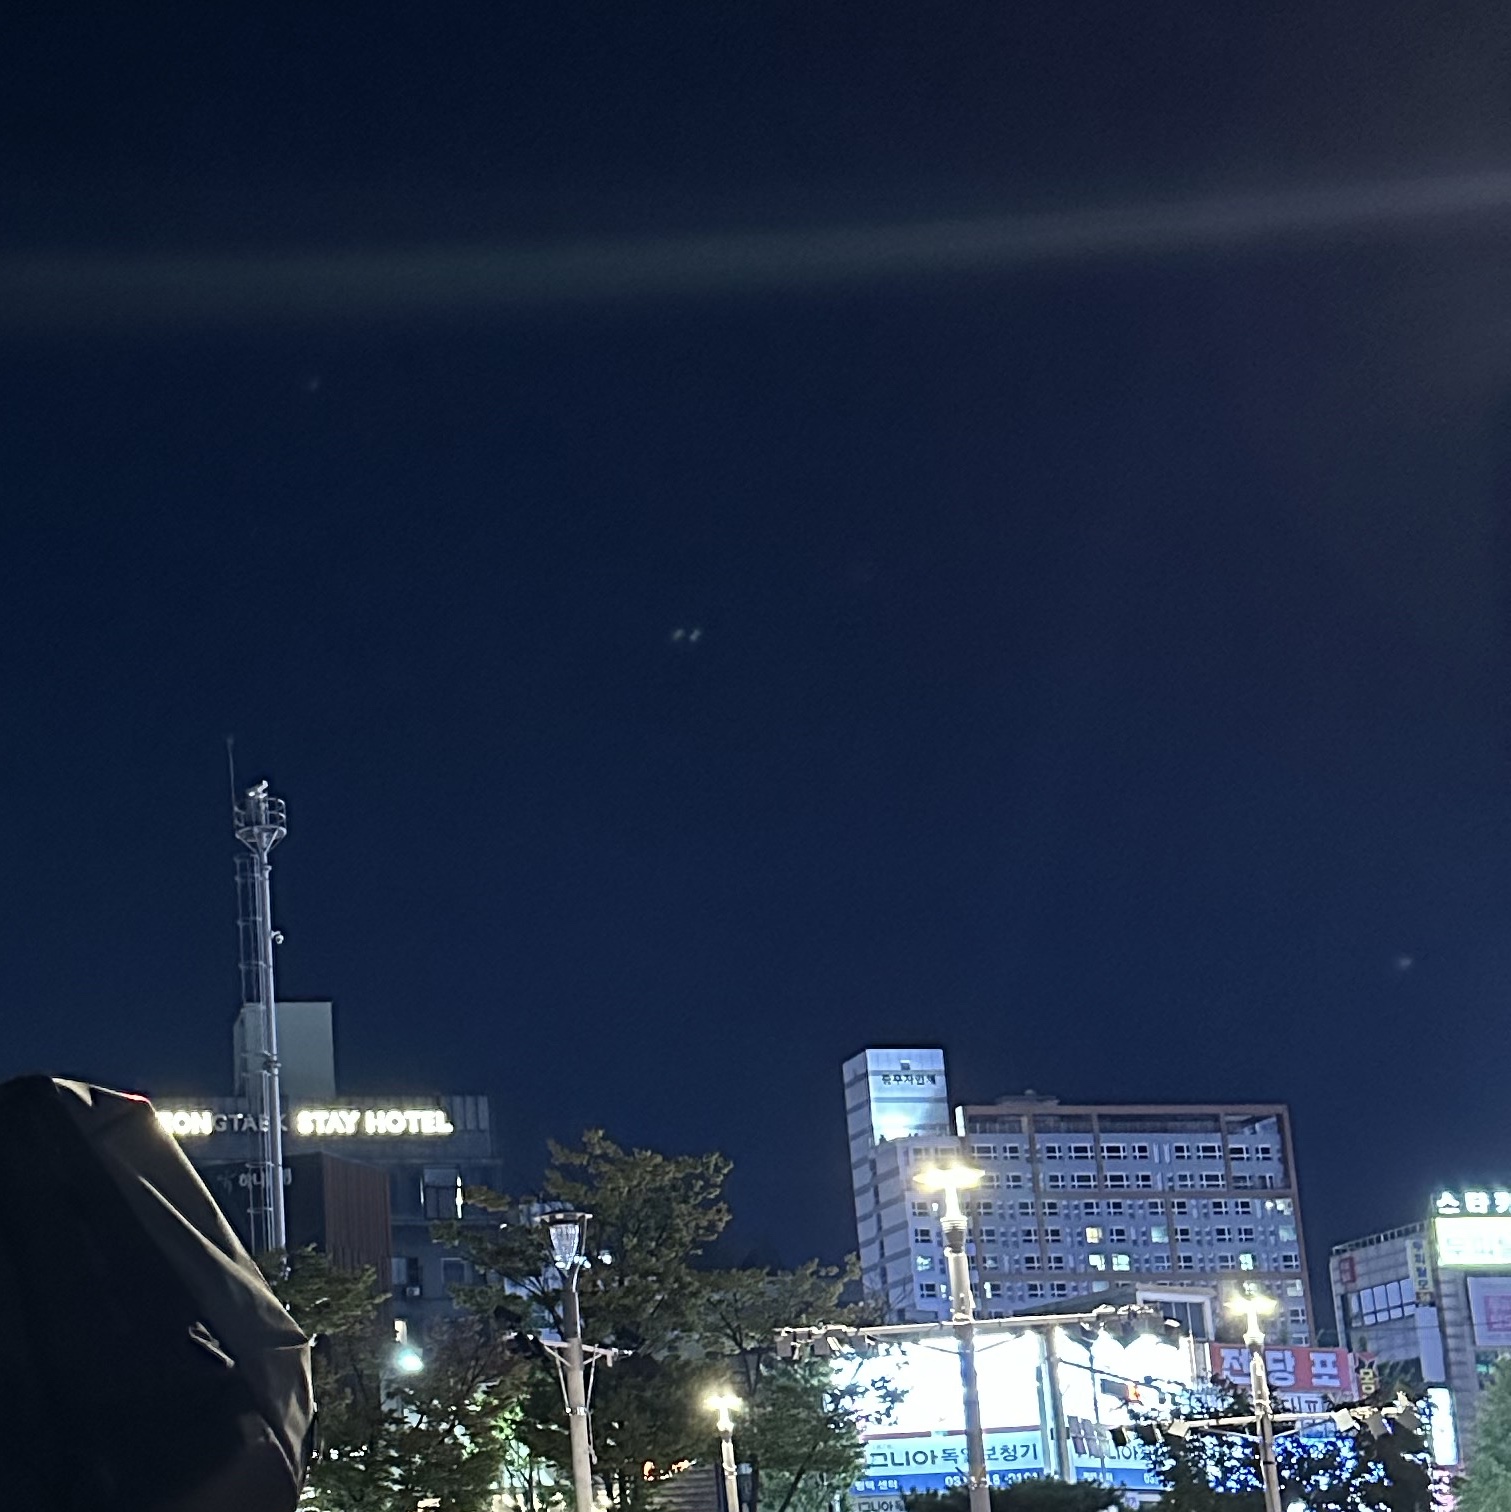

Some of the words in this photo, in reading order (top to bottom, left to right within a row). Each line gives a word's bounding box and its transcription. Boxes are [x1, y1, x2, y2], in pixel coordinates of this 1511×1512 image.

[295, 1109, 360, 1136] STAY
[364, 1109, 455, 1136] HOTEL
[1220, 1348, 1341, 1388] 전당포
